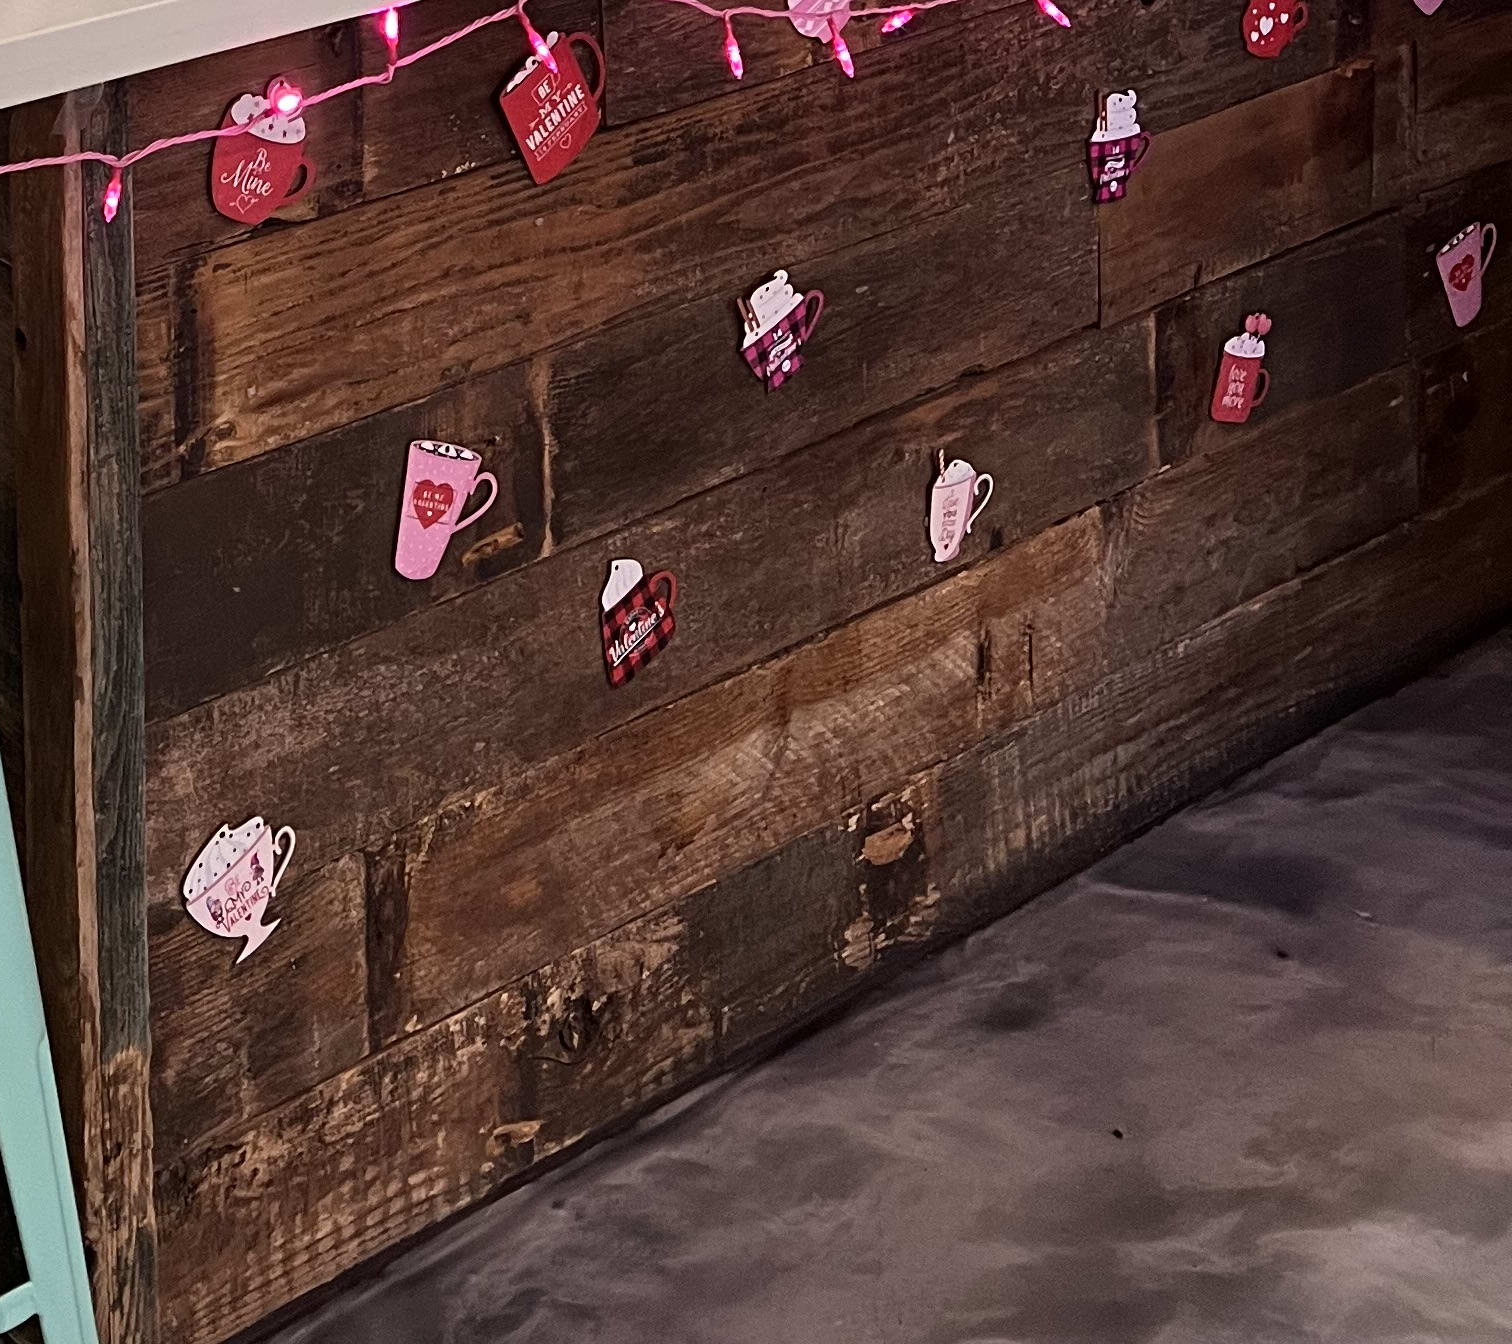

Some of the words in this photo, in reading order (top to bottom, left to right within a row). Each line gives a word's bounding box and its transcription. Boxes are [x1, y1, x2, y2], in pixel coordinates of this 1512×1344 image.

[525, 83, 586, 152] VALENTINE
[221, 160, 274, 196] Mine
[254, 148, 273, 173] Be
